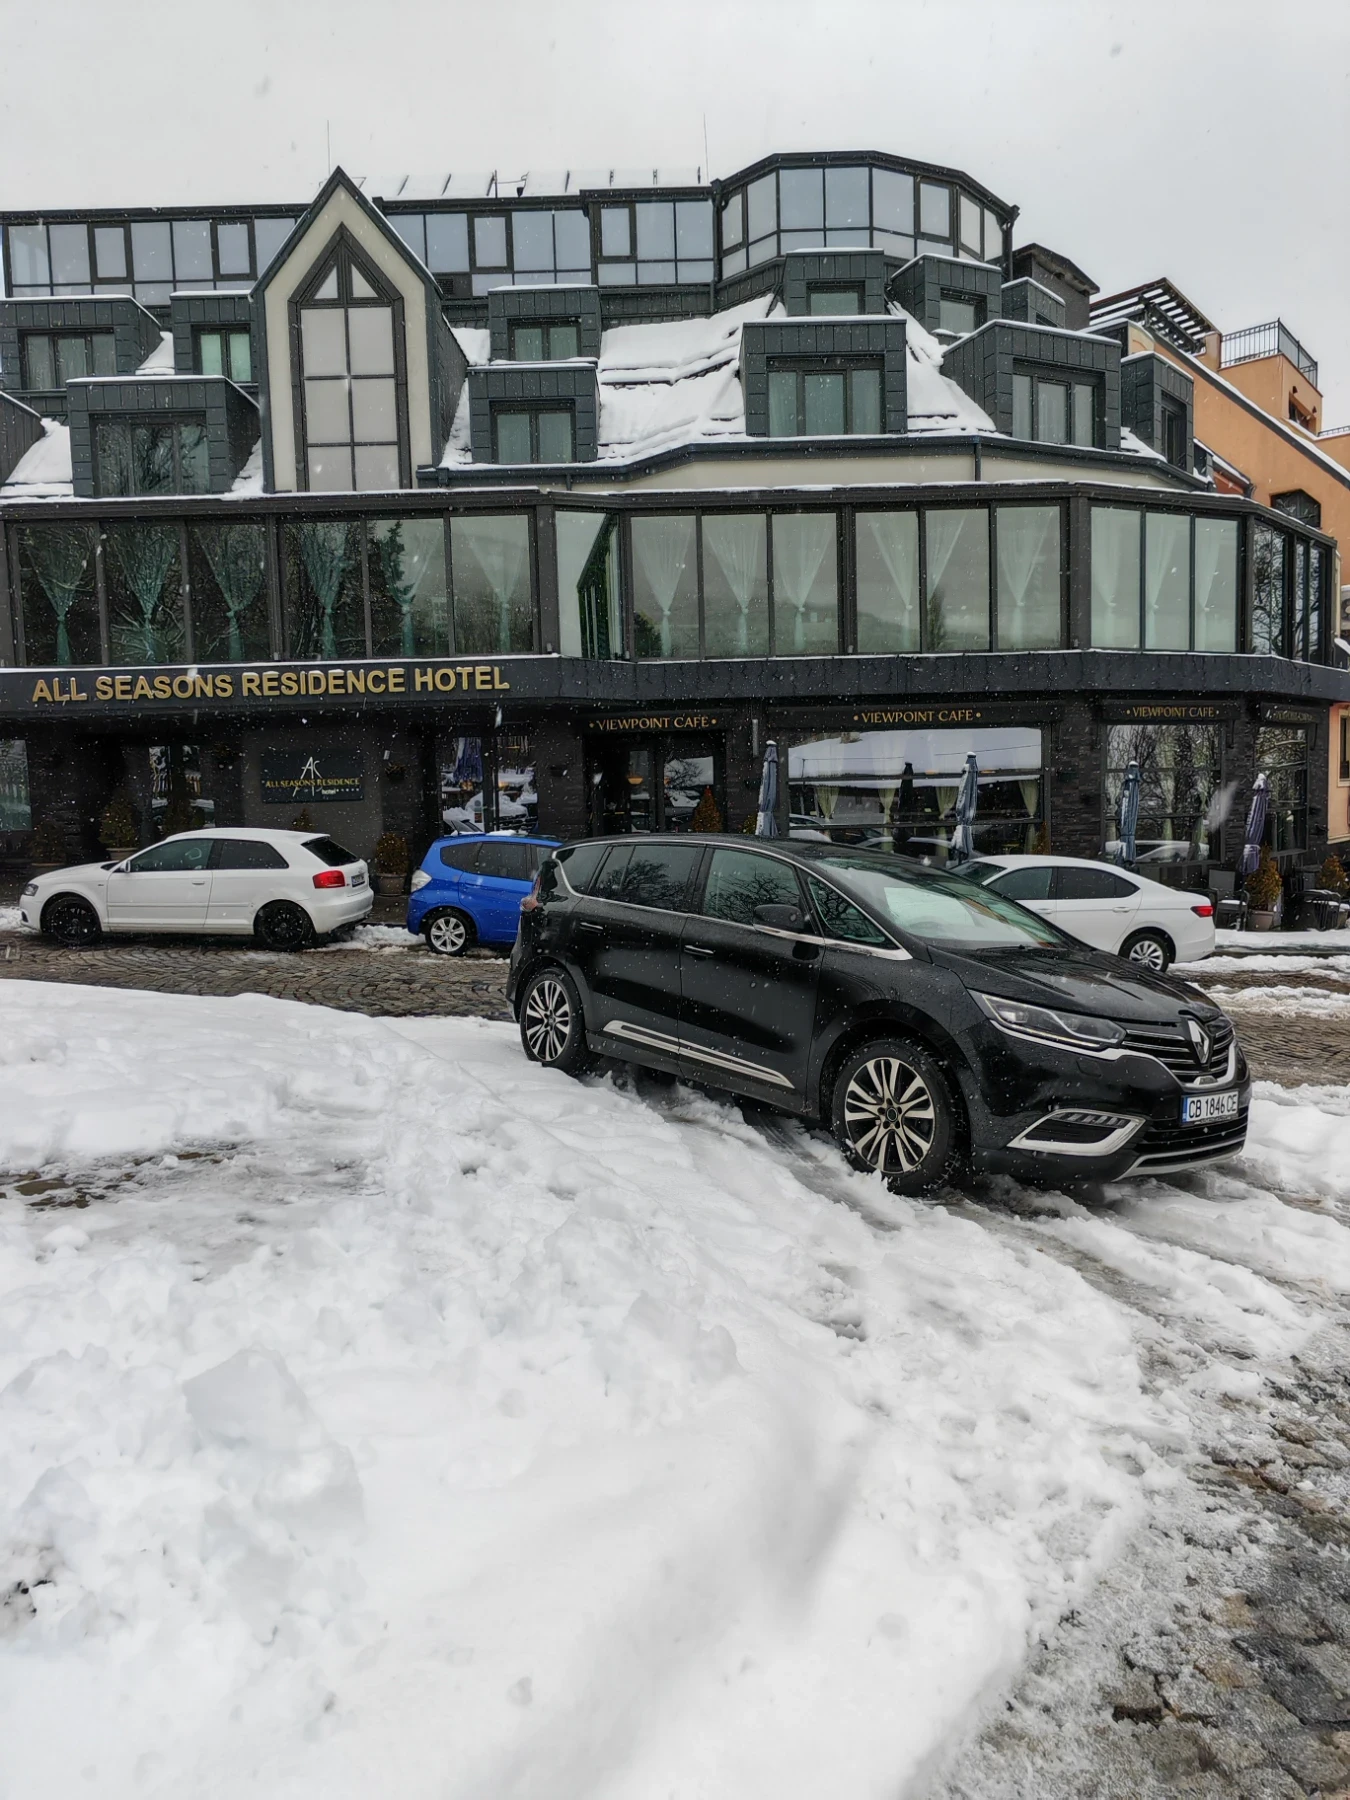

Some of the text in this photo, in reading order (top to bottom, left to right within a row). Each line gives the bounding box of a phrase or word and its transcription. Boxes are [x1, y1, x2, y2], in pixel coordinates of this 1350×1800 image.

[32, 665, 510, 702] ALL SEASONS RESIDENCE HOTEL
[861, 709, 973, 723] VIEWPOINT CAFE
[1132, 706, 1215, 718] VIEWPOINT CAFE
[596, 716, 709, 730] VIEWPOINT CAFE
[265, 777, 360, 788] ALL SEASONS RESIDENCE
[1189, 1099, 1201, 1118] CB
[1205, 1096, 1225, 1116] 1846
